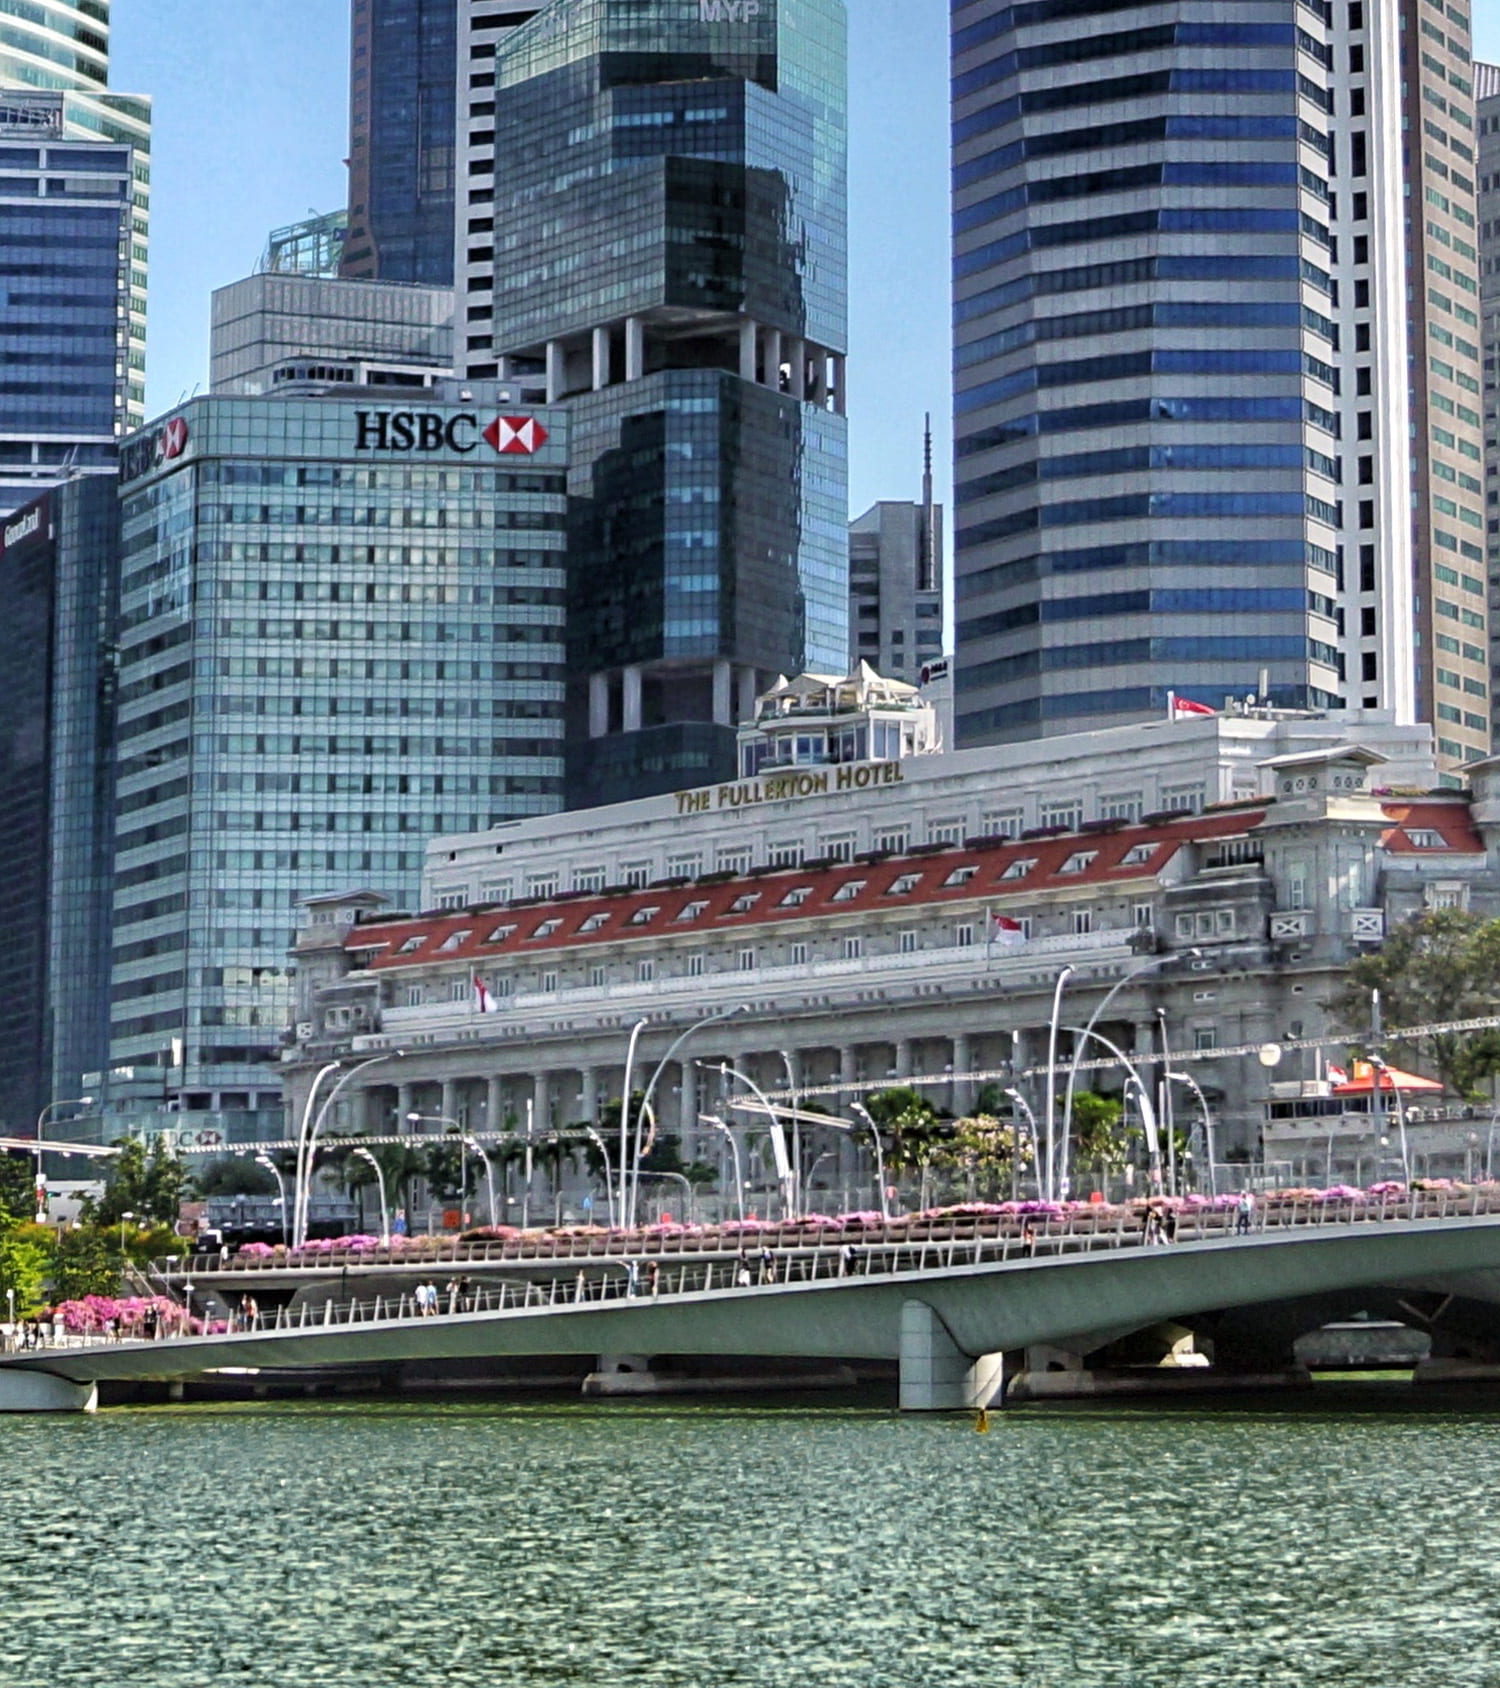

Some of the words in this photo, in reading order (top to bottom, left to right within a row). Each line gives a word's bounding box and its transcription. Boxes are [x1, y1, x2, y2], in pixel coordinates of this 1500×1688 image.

[354, 411, 477, 453] HSBC
[675, 791, 710, 814] THE
[717, 771, 828, 809] FULLERTON
[836, 760, 904, 790] HOTEL
